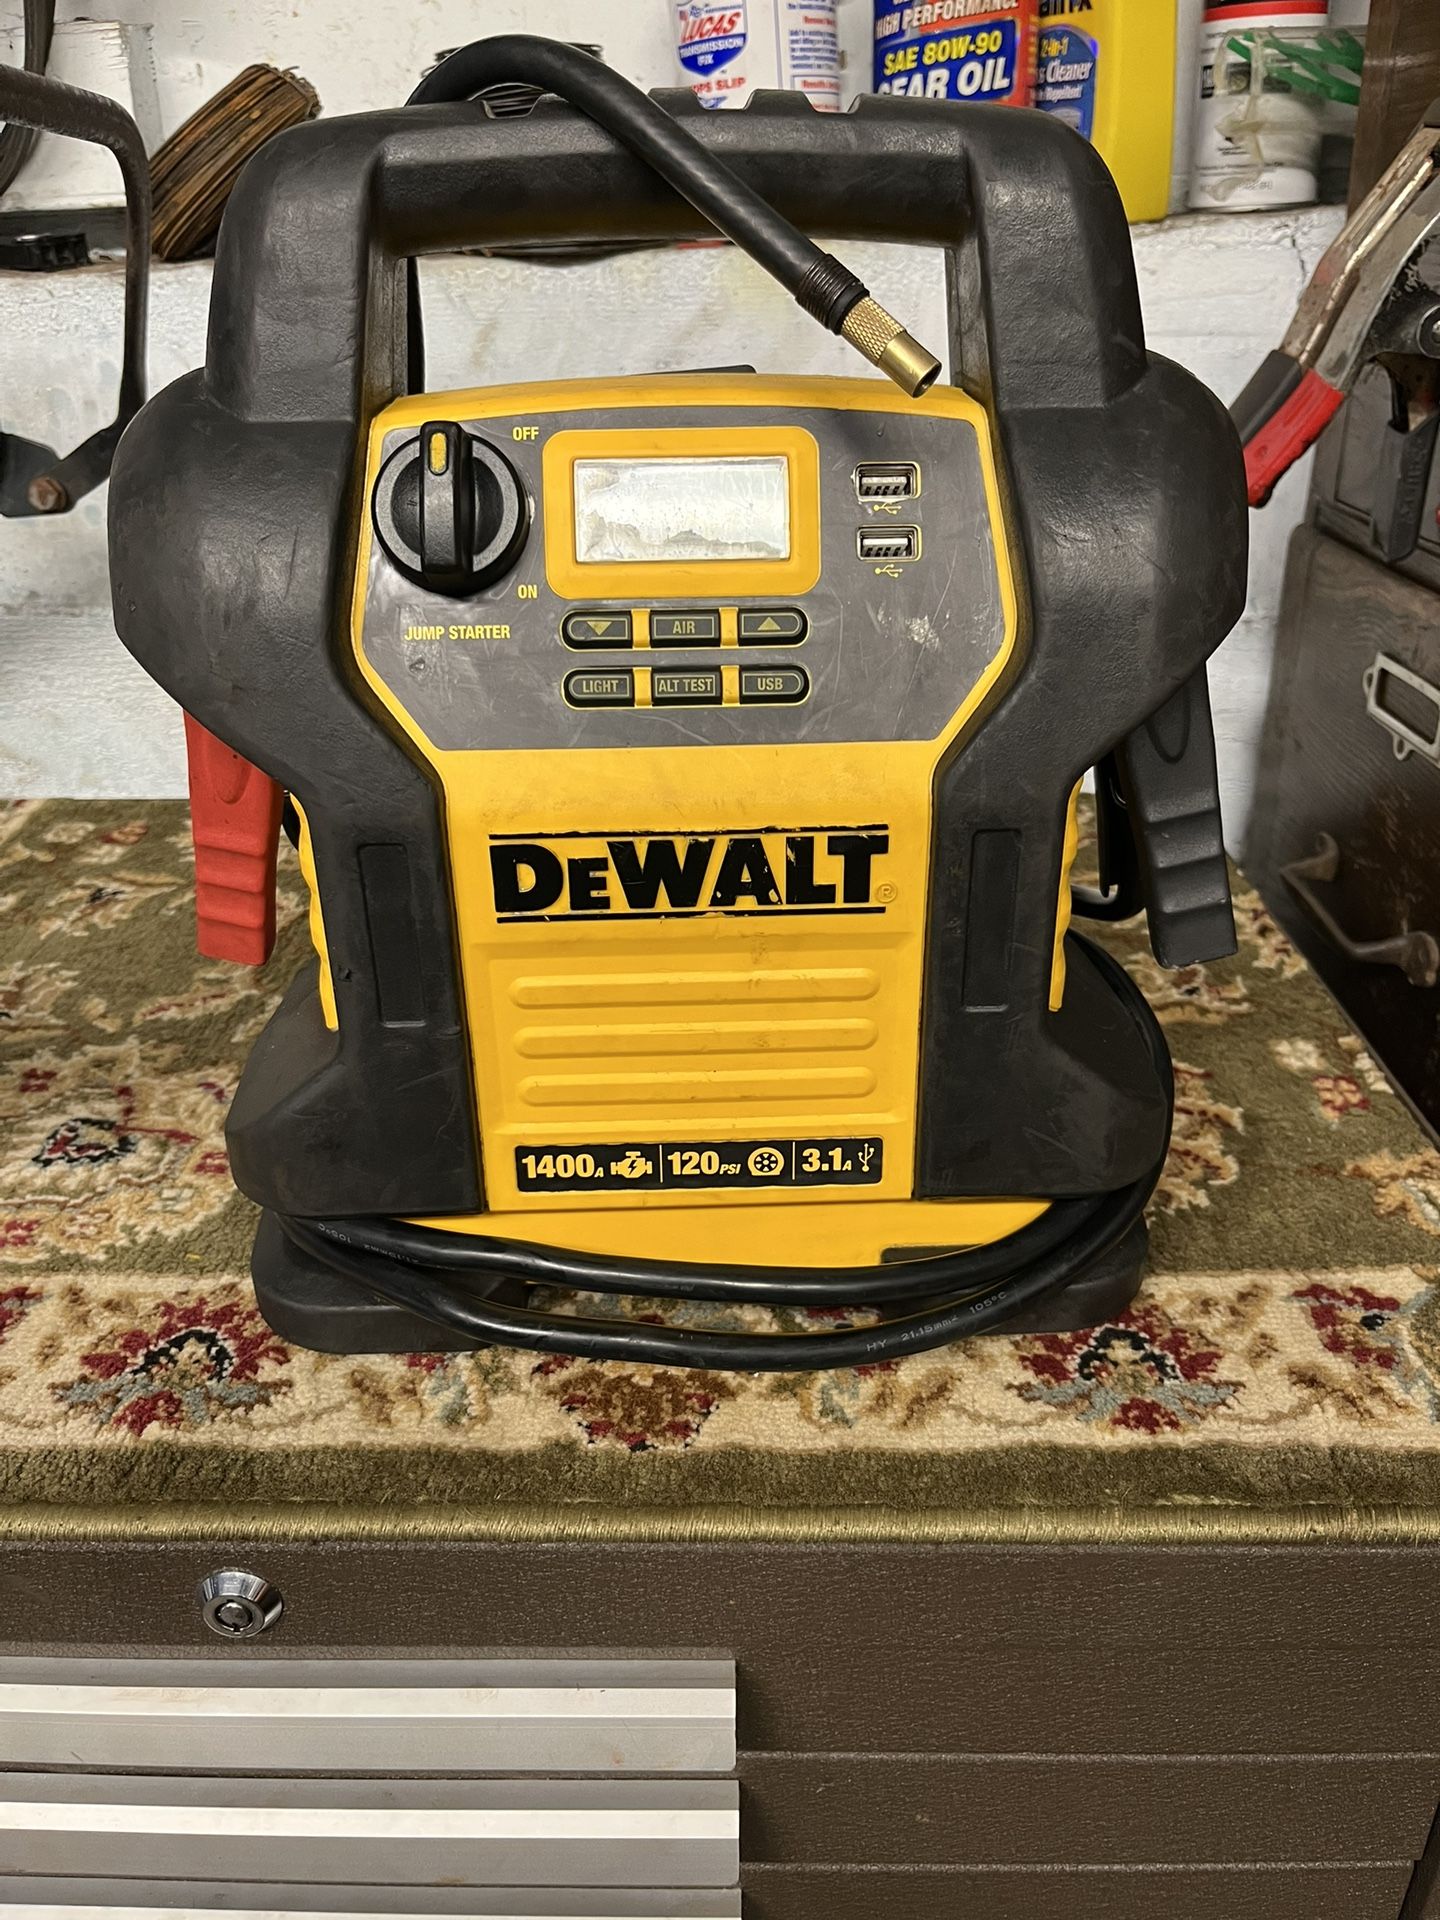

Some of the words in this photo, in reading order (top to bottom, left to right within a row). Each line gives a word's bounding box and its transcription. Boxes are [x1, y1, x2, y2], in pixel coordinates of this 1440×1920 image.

[680, 12, 741, 43] LUCAS
[876, 12, 900, 40] HIGH
[884, 45, 919, 76] SAE
[922, 30, 1002, 66] 80W-90
[957, 57, 1010, 97] OIL
[1046, 59, 1093, 83] Cleaner
[716, 77, 744, 92] SLIP
[512, 427, 539, 440] OFF
[518, 584, 537, 598] ON
[404, 626, 445, 640] JUMP
[449, 625, 510, 639] STARTER
[673, 620, 695, 634] AIR
[582, 680, 618, 693] LIGHT
[659, 679, 680, 692] ALT
[683, 678, 713, 692] TEST
[758, 677, 784, 690] USB
[489, 835, 889, 912] DEWALT
[521, 1154, 604, 1178] 1400A
[667, 1150, 741, 1175] 120PSI
[802, 1147, 852, 1172] 3.1A
[866, 1339, 887, 1352] HY
[969, 1291, 1008, 1314] 105°C
